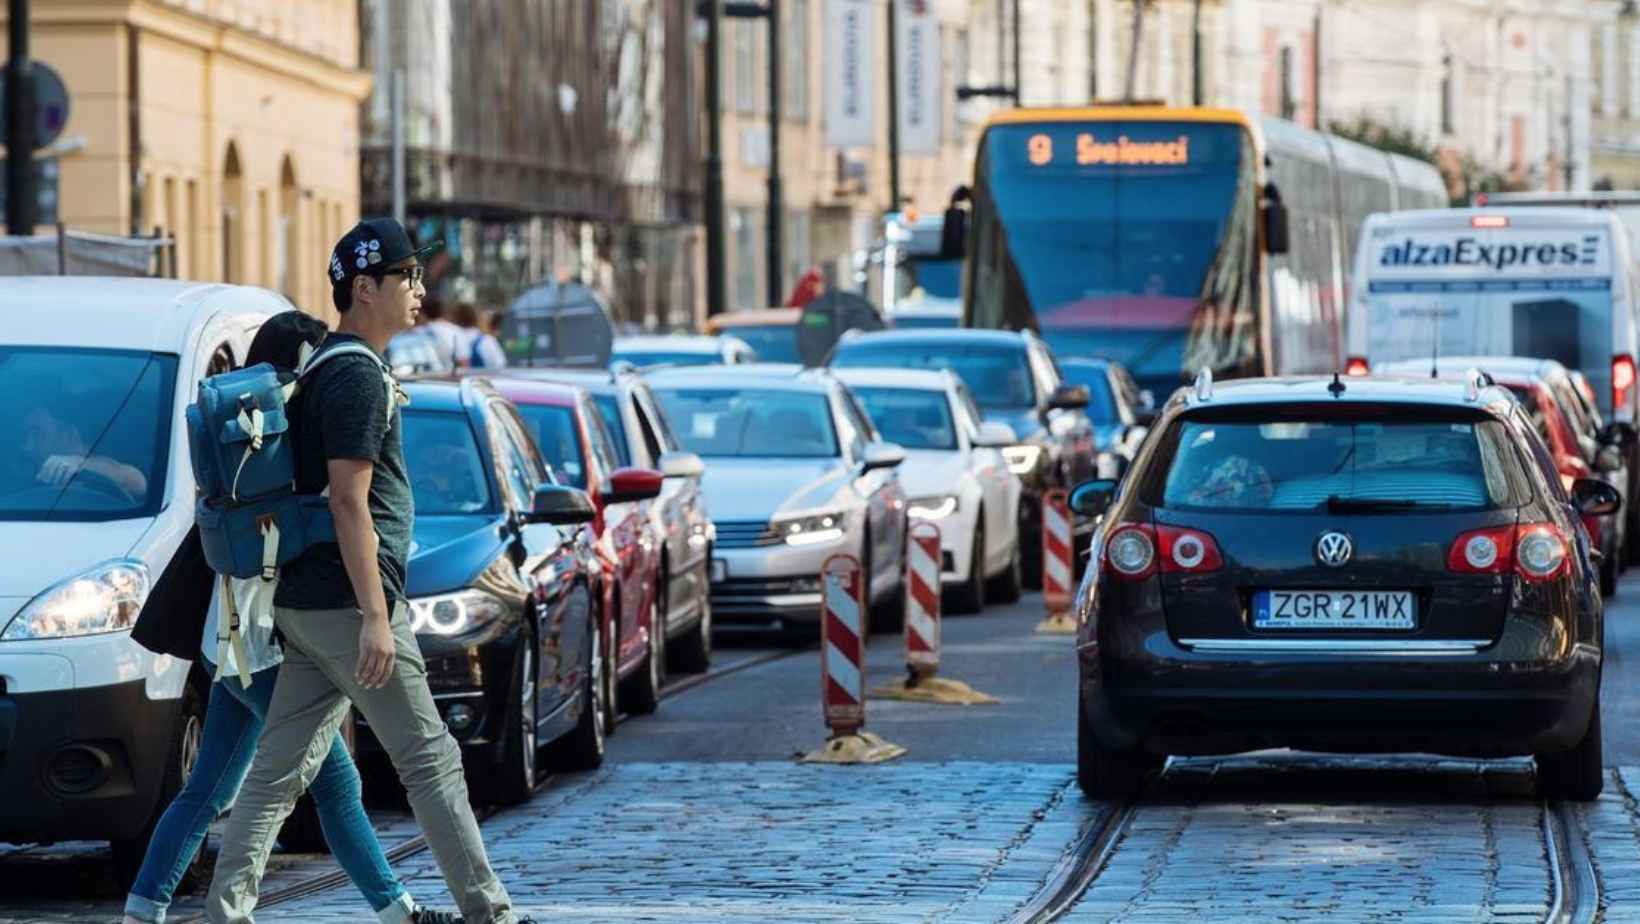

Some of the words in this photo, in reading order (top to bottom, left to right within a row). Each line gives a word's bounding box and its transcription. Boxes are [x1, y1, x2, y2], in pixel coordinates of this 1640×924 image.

[1028, 133, 1053, 165] 9
[1274, 593, 1331, 619] ZGR
[1341, 593, 1407, 619] 21WX
